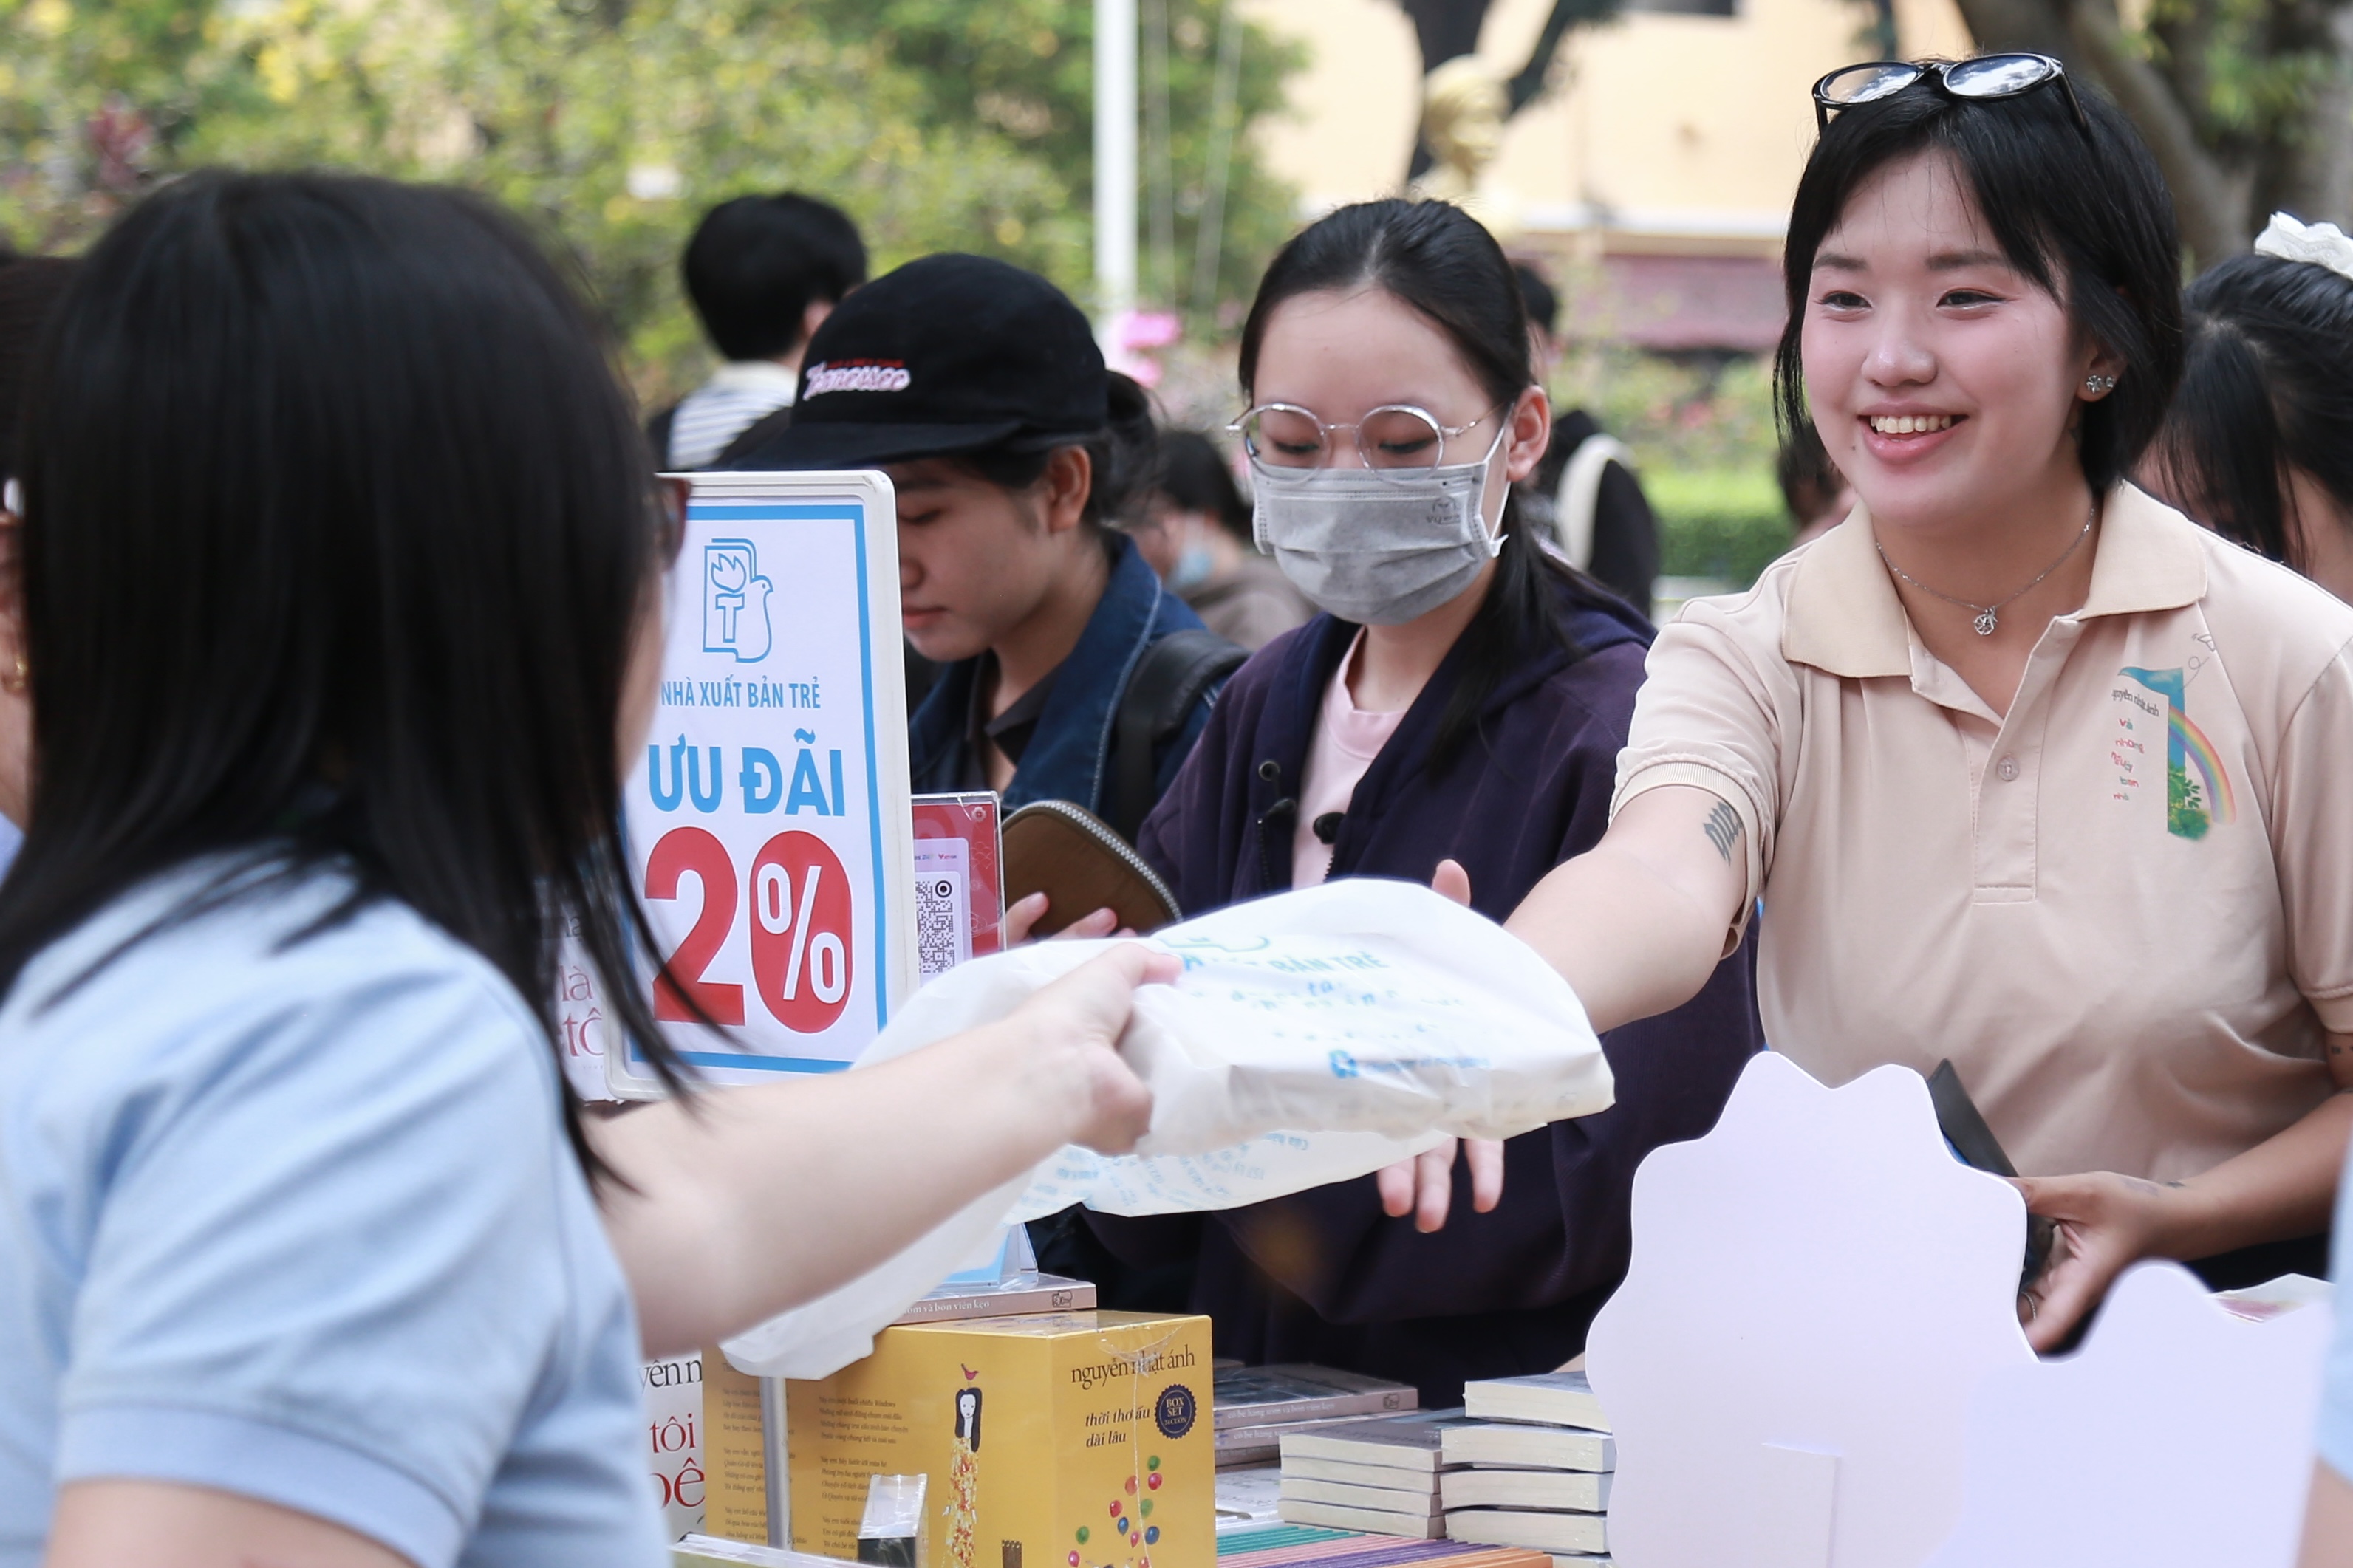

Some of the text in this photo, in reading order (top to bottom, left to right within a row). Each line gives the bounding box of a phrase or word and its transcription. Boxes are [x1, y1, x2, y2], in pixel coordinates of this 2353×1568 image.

[661, 674, 821, 708] NHÀ XUẤT BẢN TRẺ
[649, 727, 845, 816] ƯU ĐÃI
[1071, 1358, 1129, 1390] nguyễn
[1167, 1344, 1195, 1369] ánh
[1085, 1405, 1151, 1428] thời thơ ấu
[1167, 1397, 1185, 1408] BOX
[1167, 1406, 1183, 1417] SET
[649, 1413, 696, 1454] tôi
[1086, 1431, 1127, 1448] dài lâu
